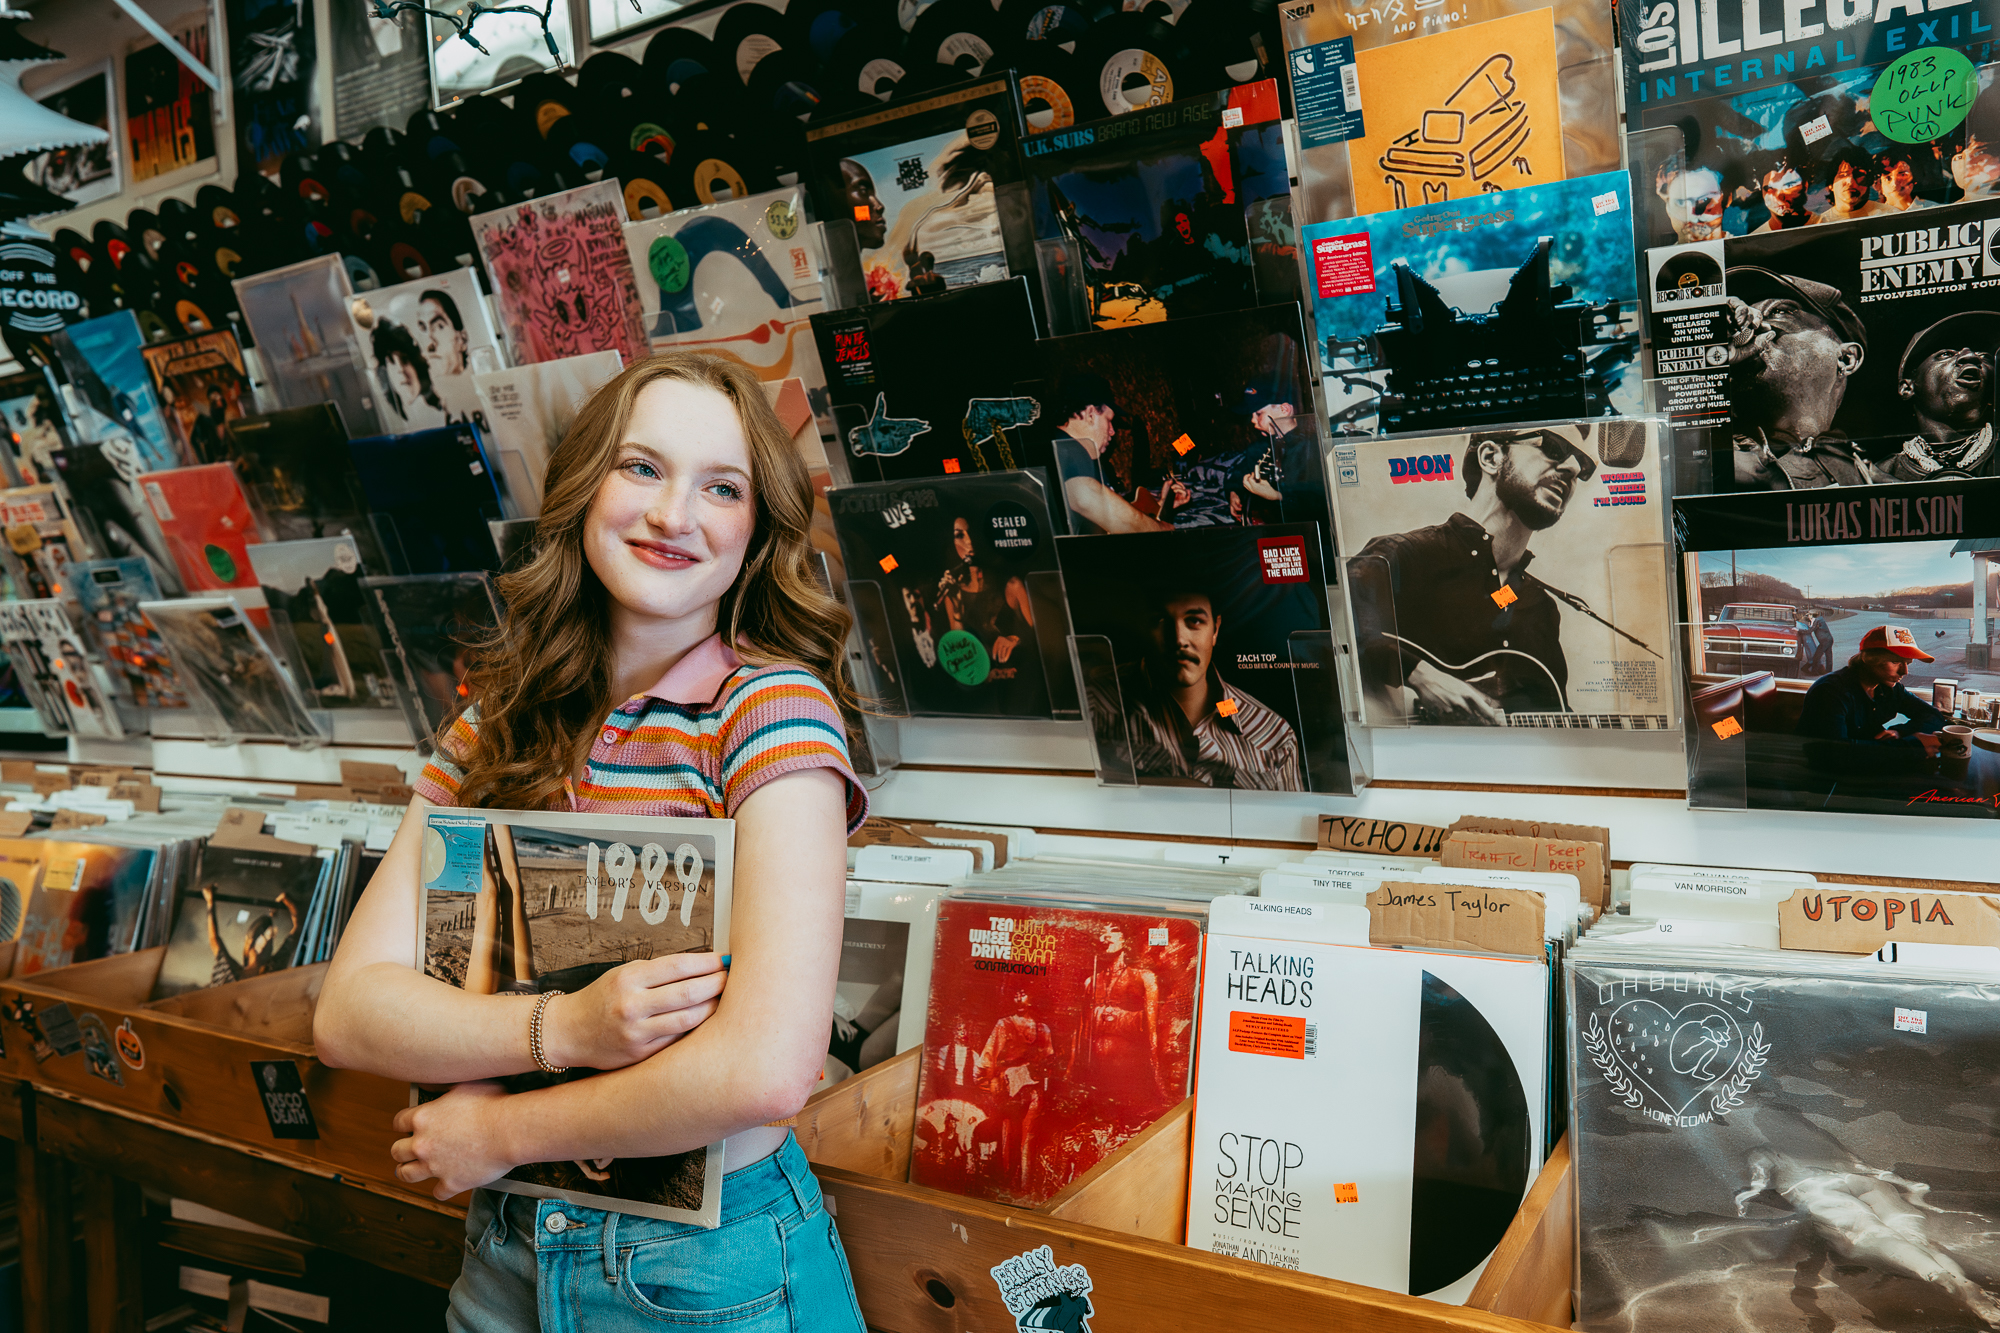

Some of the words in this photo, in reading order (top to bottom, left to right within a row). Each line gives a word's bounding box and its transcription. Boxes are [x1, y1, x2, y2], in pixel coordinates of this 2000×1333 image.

[1393, 21, 1416, 35] AND
[1637, 1, 1677, 74] LOS
[1639, 40, 1857, 103] INTERNAL
[1888, 56, 1938, 91] 1983
[1880, 93, 1973, 132] PUNK
[1023, 137, 1053, 158] U.K.
[1053, 127, 1095, 152] SUBS
[1098, 117, 1141, 143] BRAND
[1145, 109, 1177, 131] NEW
[1402, 209, 1514, 238] Supergrass
[1414, 213, 1442, 223] Going
[1442, 210, 1461, 218] Out
[1316, 240, 1367, 253] Supergrass
[1860, 220, 1982, 261] PUBLIC
[0, 269, 25, 281] OFF
[31, 271, 57, 285] THE
[1861, 255, 1981, 293] ENEMY
[0, 287, 80, 310] ECORD
[1656, 288, 1685, 304] RECORD
[1686, 286, 1711, 300] STORE
[1711, 283, 1723, 297] DAY
[1860, 283, 1967, 303] REVOLVERLUTION
[1663, 313, 1688, 324] NEVER
[1689, 310, 1720, 321] BEFORE
[1672, 319, 1711, 330] RELEASED
[1671, 335, 1693, 343] UNTIL
[1694, 333, 1714, 341] NOW
[1674, 328, 1686, 336] ON
[1686, 326, 1710, 335] VINYL
[1658, 346, 1704, 360] PUBLIC
[1658, 359, 1704, 374] ENEMY
[1662, 378, 1679, 386] ONE
[1680, 377, 1691, 385] OF
[1691, 375, 1706, 384] THE
[1707, 373, 1728, 381] MOST
[1668, 381, 1716, 392] INFLUENTIAL
[1668, 396, 1699, 406] GROUPS
[1708, 394, 1724, 402] THE
[1675, 388, 1717, 398] POWERFUL
[1662, 403, 1695, 413] HISTORY
[1707, 400, 1731, 408] MUSIC
[1388, 453, 1454, 485] DION
[1600, 471, 1646, 484] WONDER
[1607, 483, 1646, 495] WHERE
[1593, 496, 1610, 507] I'M
[1611, 495, 1647, 507] BOUND
[992, 516, 1027, 528] SEALED
[1786, 501, 1862, 542] LUKAS
[1870, 495, 1964, 539] NELSON
[1004, 529, 1018, 538] FOR
[994, 538, 1033, 548] PROTECTION
[1262, 549, 1278, 559] BAD
[1279, 547, 1300, 557] LUCK
[1266, 569, 1281, 578] THE
[1282, 567, 1303, 577] RADIO
[1236, 654, 1260, 663] ZACH
[1260, 653, 1277, 662] TOP
[1906, 788, 1990, 807] American
[1546, 844, 1585, 857] BEEP
[914, 855, 932, 863] SWIFT
[1218, 855, 1229, 865] T
[1550, 859, 1586, 872] BEEP
[578, 875, 637, 889] TAYLOR'S
[647, 880, 709, 893] VERSION
[586, 841, 704, 928] 1989
[1313, 879, 1330, 887] TINY
[1331, 881, 1352, 889] TREE
[1674, 882, 1693, 890] VAN
[1695, 884, 1747, 895] MORRISON
[1249, 902, 1283, 913] TALKING
[1285, 906, 1312, 916] HEADS
[1377, 888, 1436, 908] James
[1447, 891, 1510, 918] Taylor
[1803, 894, 1954, 931] UTOPIA
[989, 916, 1014, 932] TEN
[1659, 924, 1673, 933] U2
[843, 940, 886, 950] DEPARTMENT
[969, 928, 1012, 946] WHEEL
[1011, 932, 1056, 950] GENYA
[971, 943, 1011, 960] DRIVE
[1010, 946, 1053, 965] RAVAN
[1877, 942, 1898, 963] U
[974, 960, 1039, 976] CONSTRUCTION
[1230, 950, 1314, 979] TALKING
[1227, 973, 1313, 1008] HEADS
[265, 1092, 302, 1108] DISCO
[270, 1107, 309, 1126] DEATH
[1643, 1105, 1714, 1128] HONEYCOMA
[1217, 1132, 1304, 1189] STOP
[1215, 1178, 1302, 1209] MAKING
[1213, 1194, 1302, 1239] SENSE
[1212, 1233, 1234, 1241] MUSIC
[1269, 1244, 1286, 1252] FILM
[1212, 1240, 1239, 1252] JONATHAN
[1242, 1247, 1268, 1264] AND
[1269, 1252, 1300, 1266] TALKING
[993, 1247, 1054, 1293] BILLY
